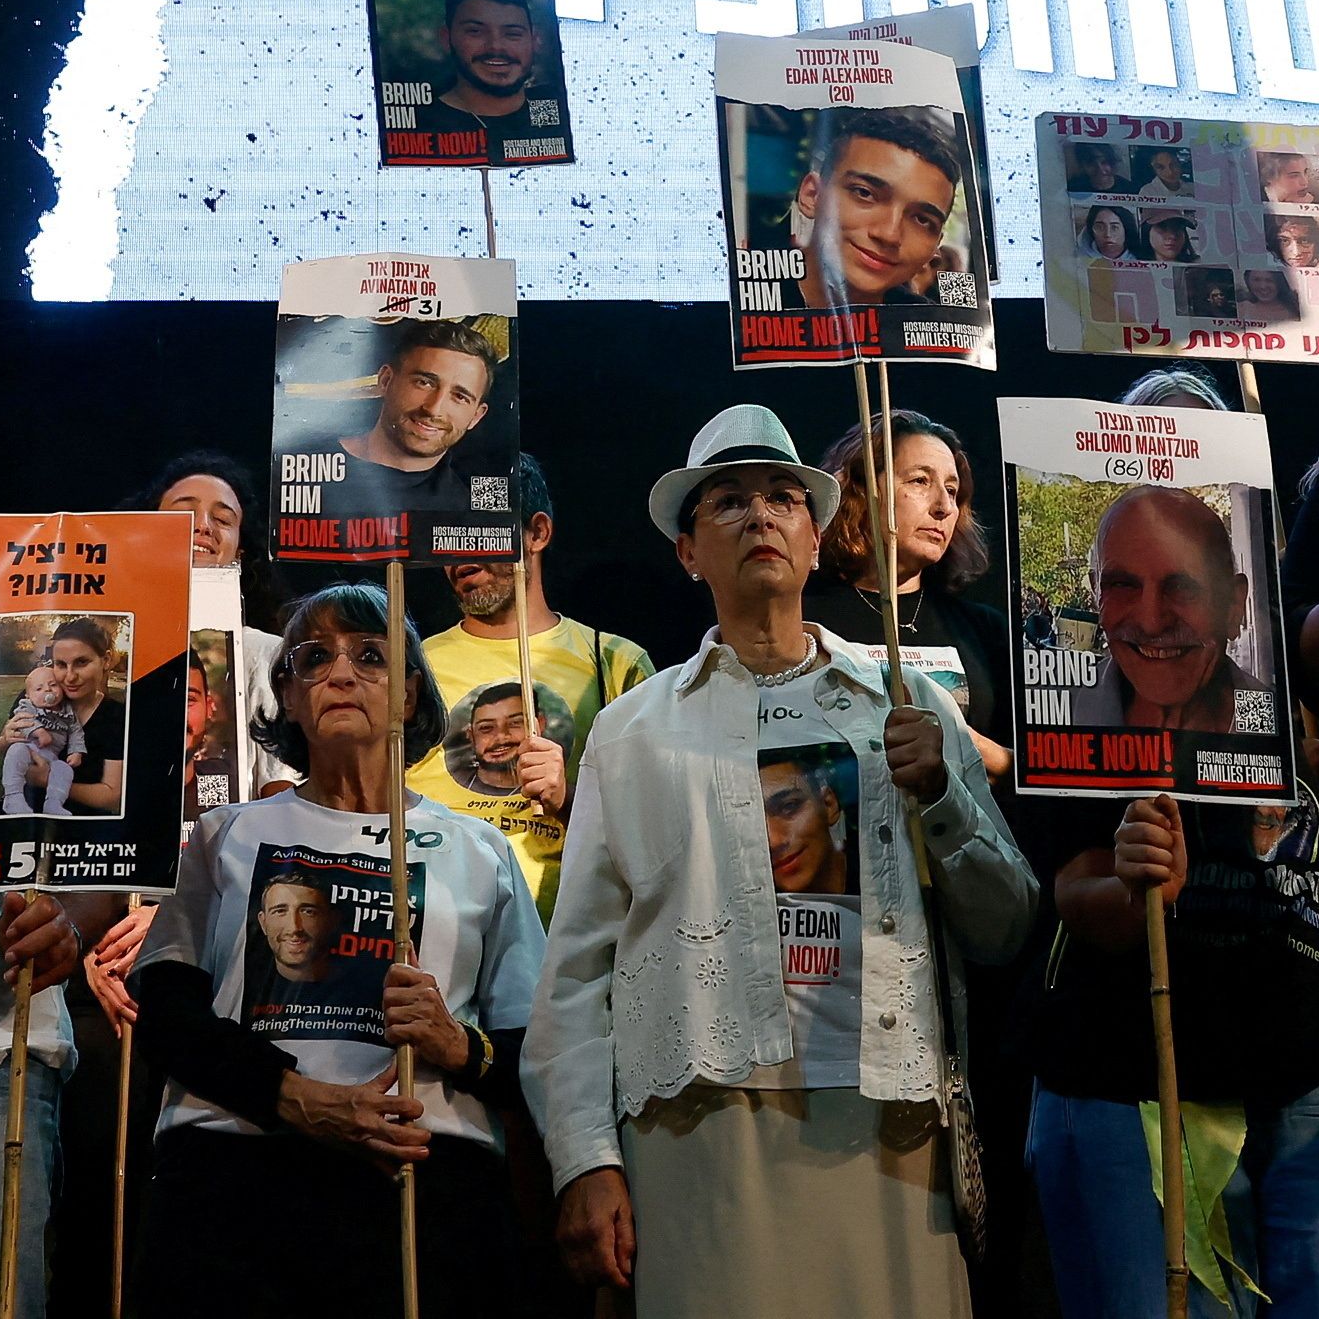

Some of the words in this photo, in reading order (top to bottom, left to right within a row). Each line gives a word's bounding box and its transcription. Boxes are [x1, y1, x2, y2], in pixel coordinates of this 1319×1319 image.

[795, 48, 850, 66] אלכסנדר
[853, 49, 880, 68] עידן
[785, 67, 819, 85] EDAN
[822, 68, 893, 85] ALEXANDER
[829, 85, 854, 104] (20)
[1049, 114, 1108, 137] עוז
[1118, 115, 1183, 145] נחל
[386, 132, 434, 155] HOME
[438, 130, 487, 155] NOW!
[504, 147, 538, 159] FAMILIES
[539, 146, 566, 157] FORUM
[368, 261, 388, 277] אור
[391, 262, 430, 279] אבינתן
[736, 249, 805, 280] BRING
[360, 279, 418, 295] AVINATAN
[420, 281, 437, 296] OR
[418, 299, 442, 317] 31
[741, 314, 807, 347] HOME
[812, 308, 880, 347] NOW!
[1095, 410, 1134, 431] מנצור
[1137, 415, 1175, 435] שלמה
[1076, 431, 1132, 454] SHLOMO
[1136, 435, 1200, 459] MANTZUR
[1105, 457, 1144, 480] (86)
[280, 485, 322, 514] HIM
[280, 518, 340, 547] HOME
[346, 513, 409, 549] NOW!
[7, 541, 64, 566] יציל
[76, 542, 107, 565] מי
[8, 573, 106, 597] אותנו?
[1024, 649, 1097, 687] BRING
[1025, 689, 1071, 726] HIM
[1196, 750, 1233, 765] HOSTAGES
[1234, 753, 1248, 766] AND
[1249, 754, 1282, 768] MISSING
[1197, 763, 1243, 785] FAMILIES
[1245, 766, 1282, 786] FORUM
[8, 842, 36, 878] 5
[41, 842, 80, 858] מציין
[85, 843, 137, 858] אריאל
[54, 862, 108, 877] הולדת
[113, 862, 136, 877] יום
[796, 911, 841, 940] EDAN
[330, 934, 395, 960] חיים.
[251, 1018, 384, 1036] #BringThemHomeNo
